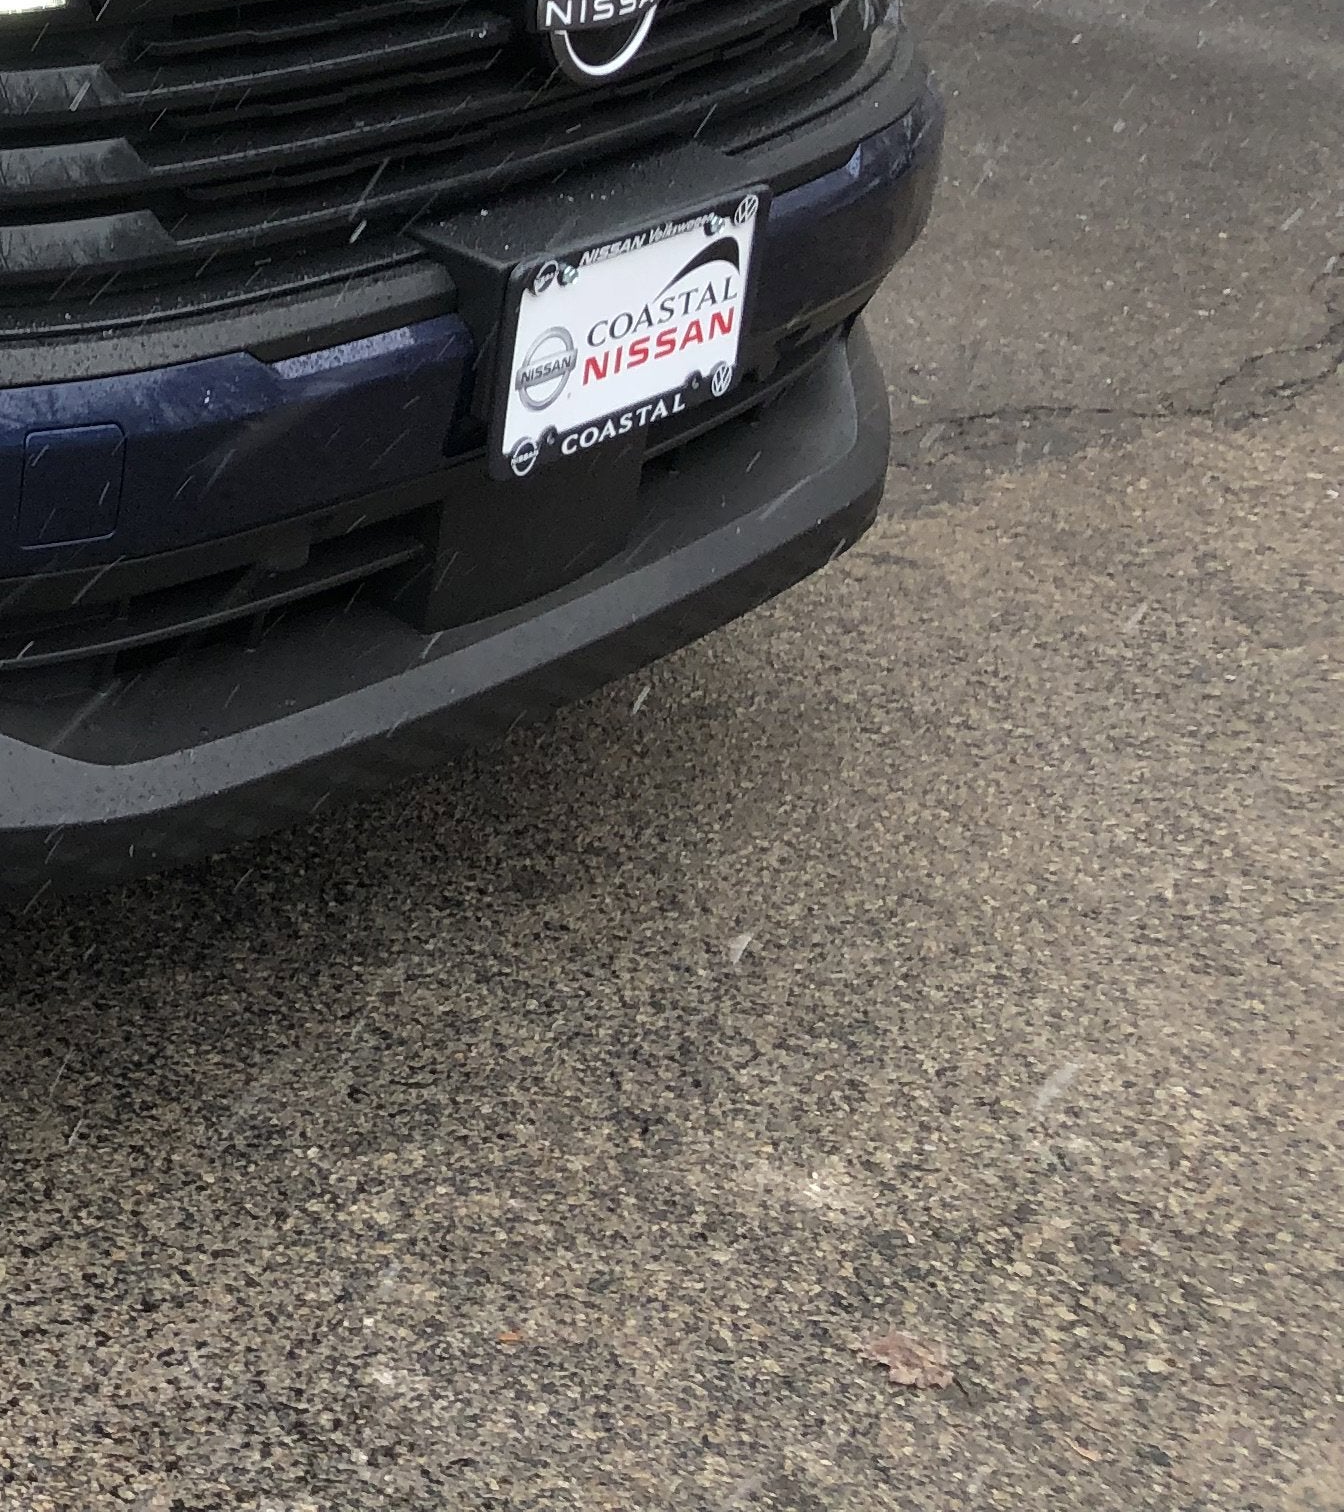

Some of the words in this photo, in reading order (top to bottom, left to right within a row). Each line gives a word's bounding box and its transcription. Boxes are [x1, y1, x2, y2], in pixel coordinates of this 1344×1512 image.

[578, 232, 646, 267] NISSAN
[587, 276, 738, 348] COASTAL
[520, 355, 572, 386] NISSAN
[582, 307, 735, 387] NISSAN
[561, 393, 687, 456] COASTAL
